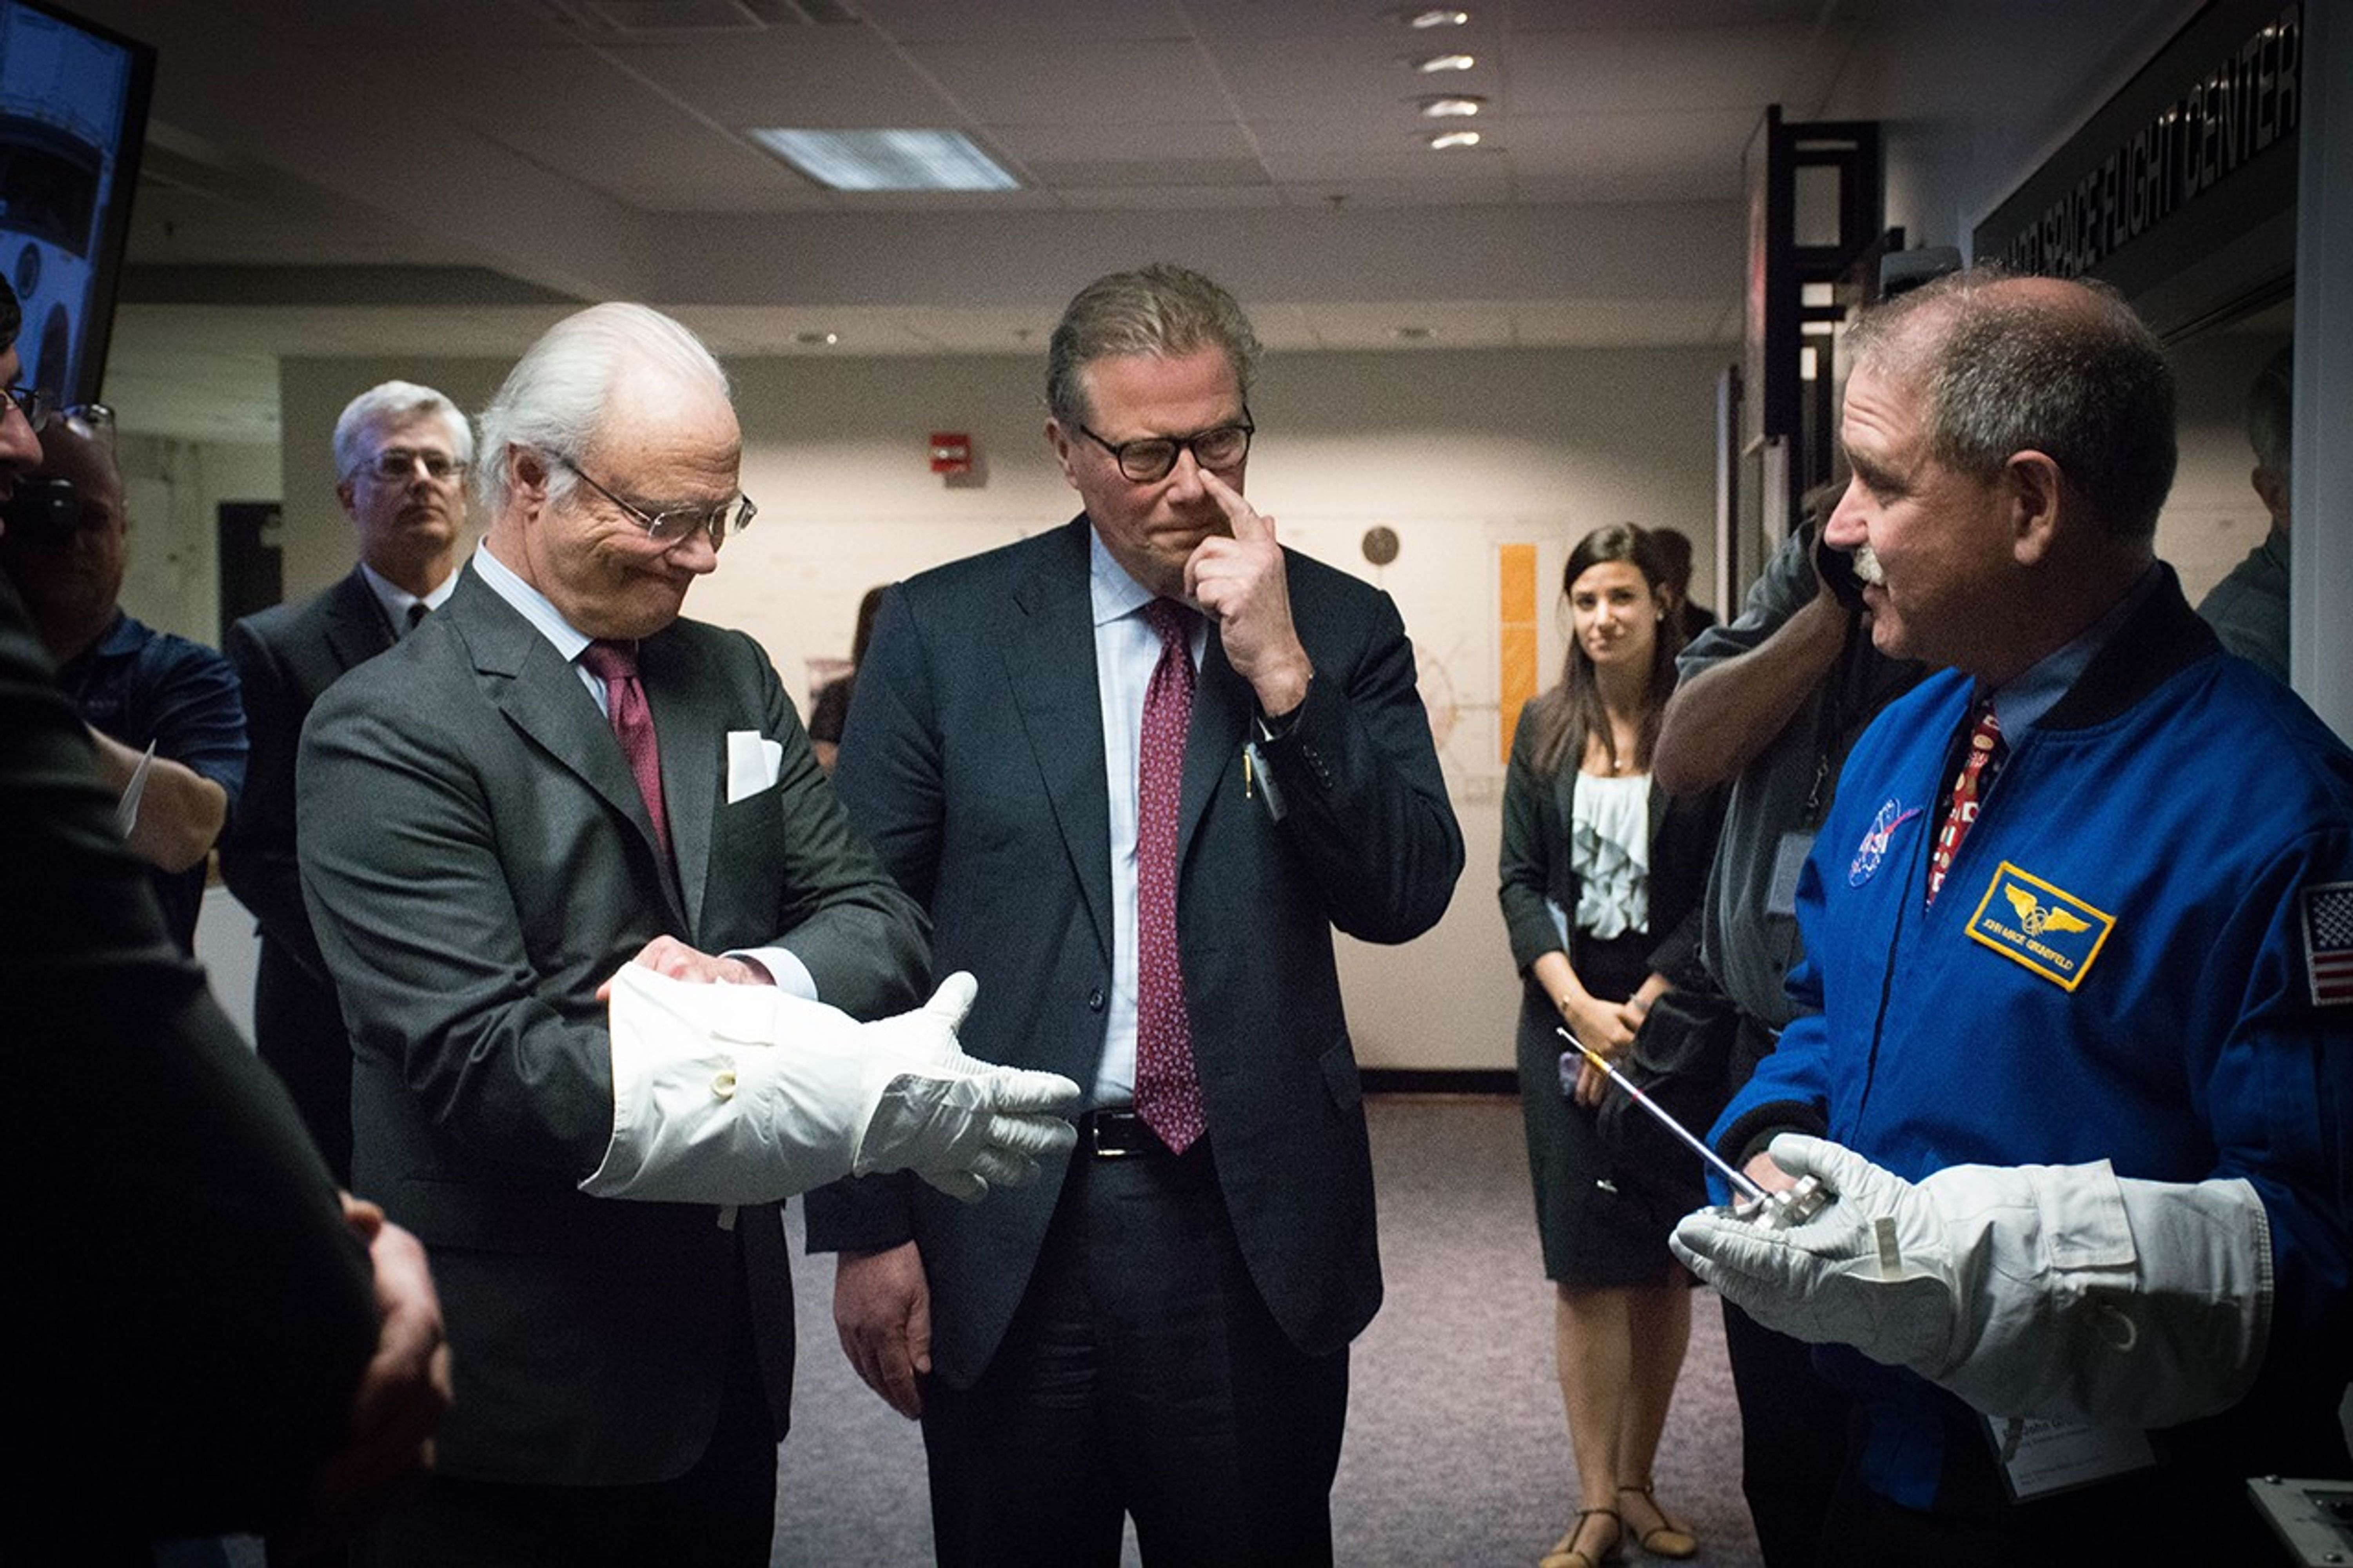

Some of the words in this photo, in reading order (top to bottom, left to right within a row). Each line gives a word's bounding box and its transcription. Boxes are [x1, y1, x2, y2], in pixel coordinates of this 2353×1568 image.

[2043, 171, 2098, 276] SPACE
[2103, 101, 2177, 256] FLIGHT
[2183, 5, 2298, 201] CENTER
